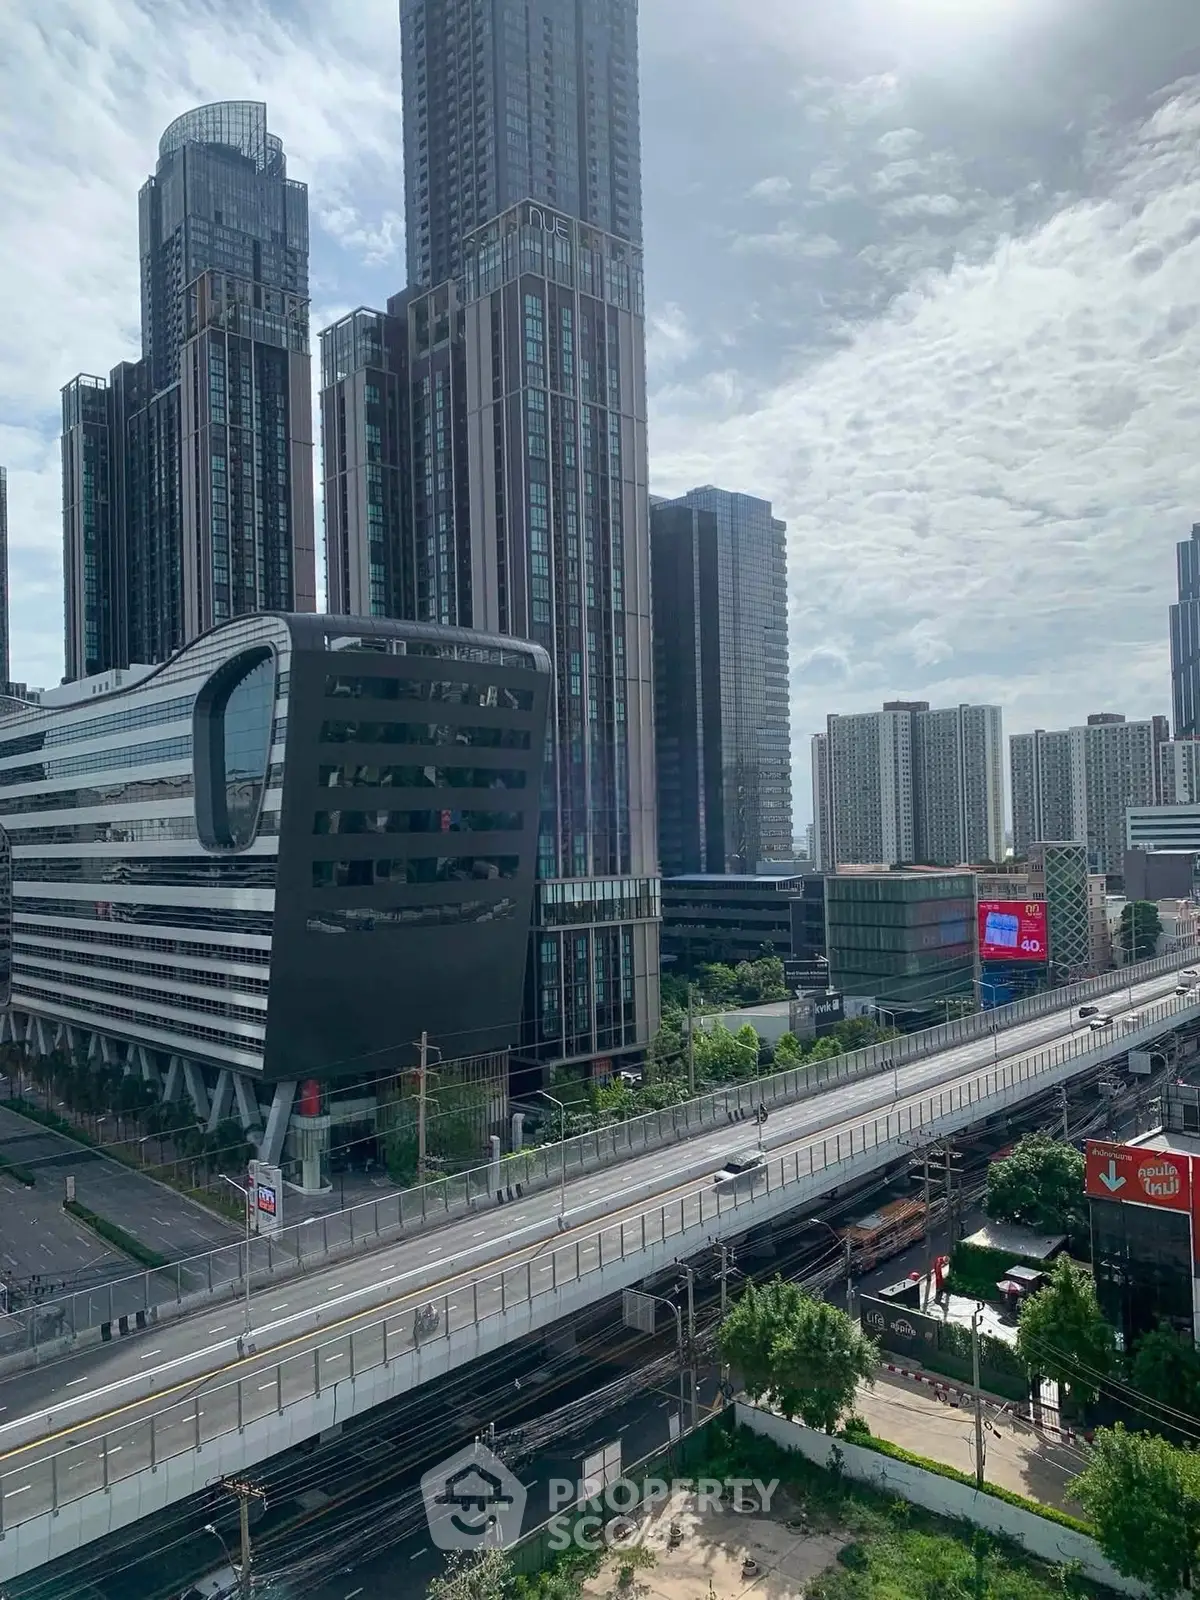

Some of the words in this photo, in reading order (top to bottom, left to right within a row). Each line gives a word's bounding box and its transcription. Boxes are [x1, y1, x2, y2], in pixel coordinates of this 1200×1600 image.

[815, 1001, 832, 1014] kvik
[1092, 1147, 1133, 1161] สำนักงานขาย
[1138, 1162, 1178, 1178] คอนโด
[1144, 1176, 1180, 1196] ใหม่!
[890, 1321, 917, 1336] aspire
